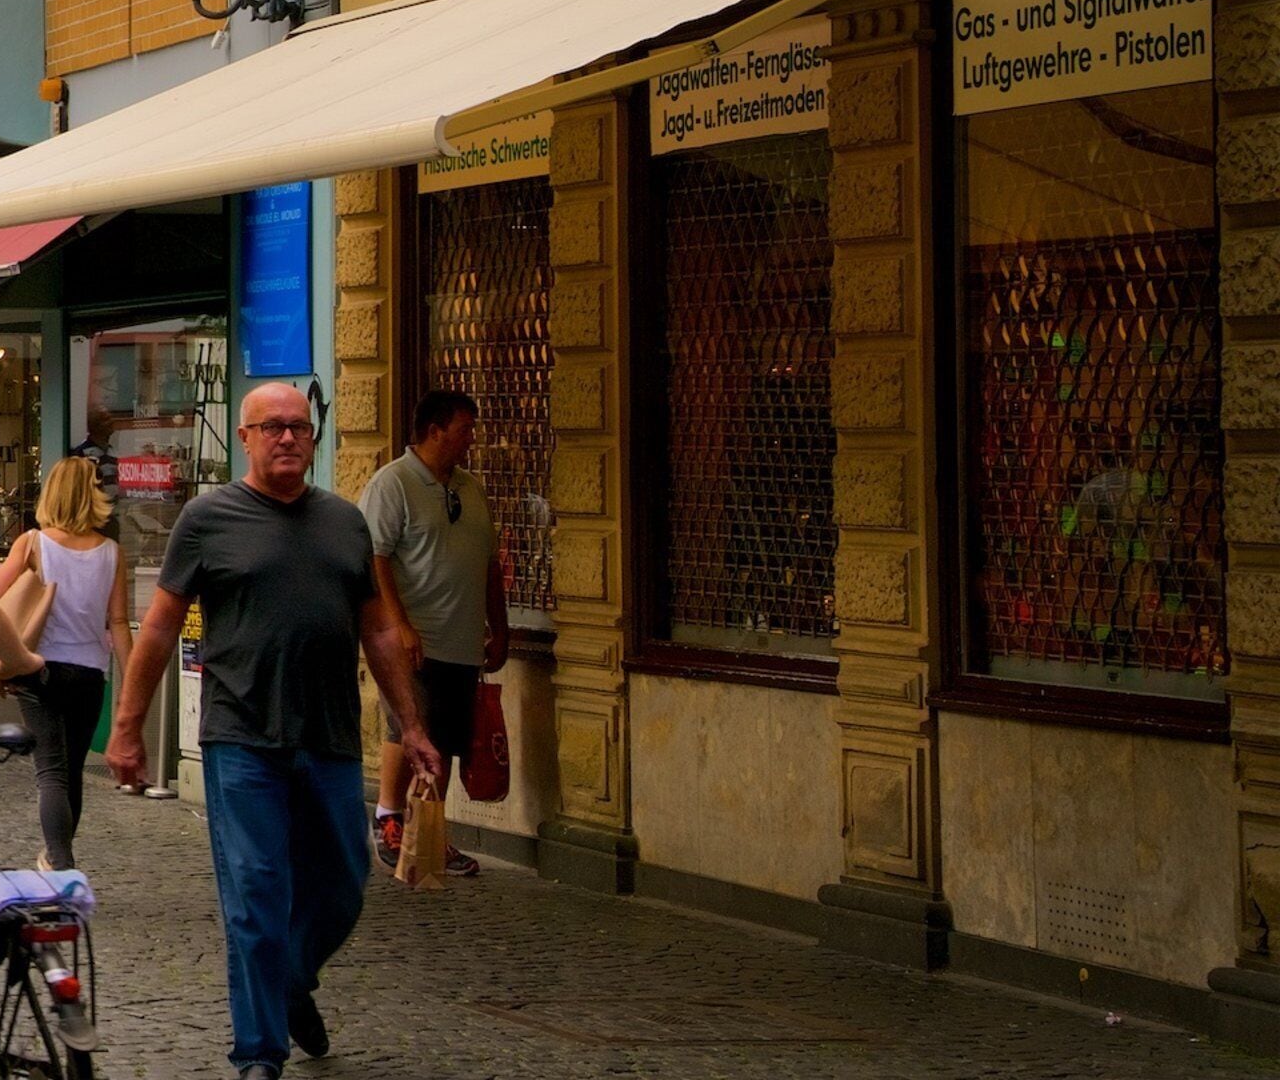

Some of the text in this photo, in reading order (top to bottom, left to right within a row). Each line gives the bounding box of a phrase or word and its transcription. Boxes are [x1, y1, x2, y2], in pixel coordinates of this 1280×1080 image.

[955, 6, 996, 42] Gas
[962, 40, 1093, 93] Luftgewehre
[1114, 22, 1206, 68] Pistolen
